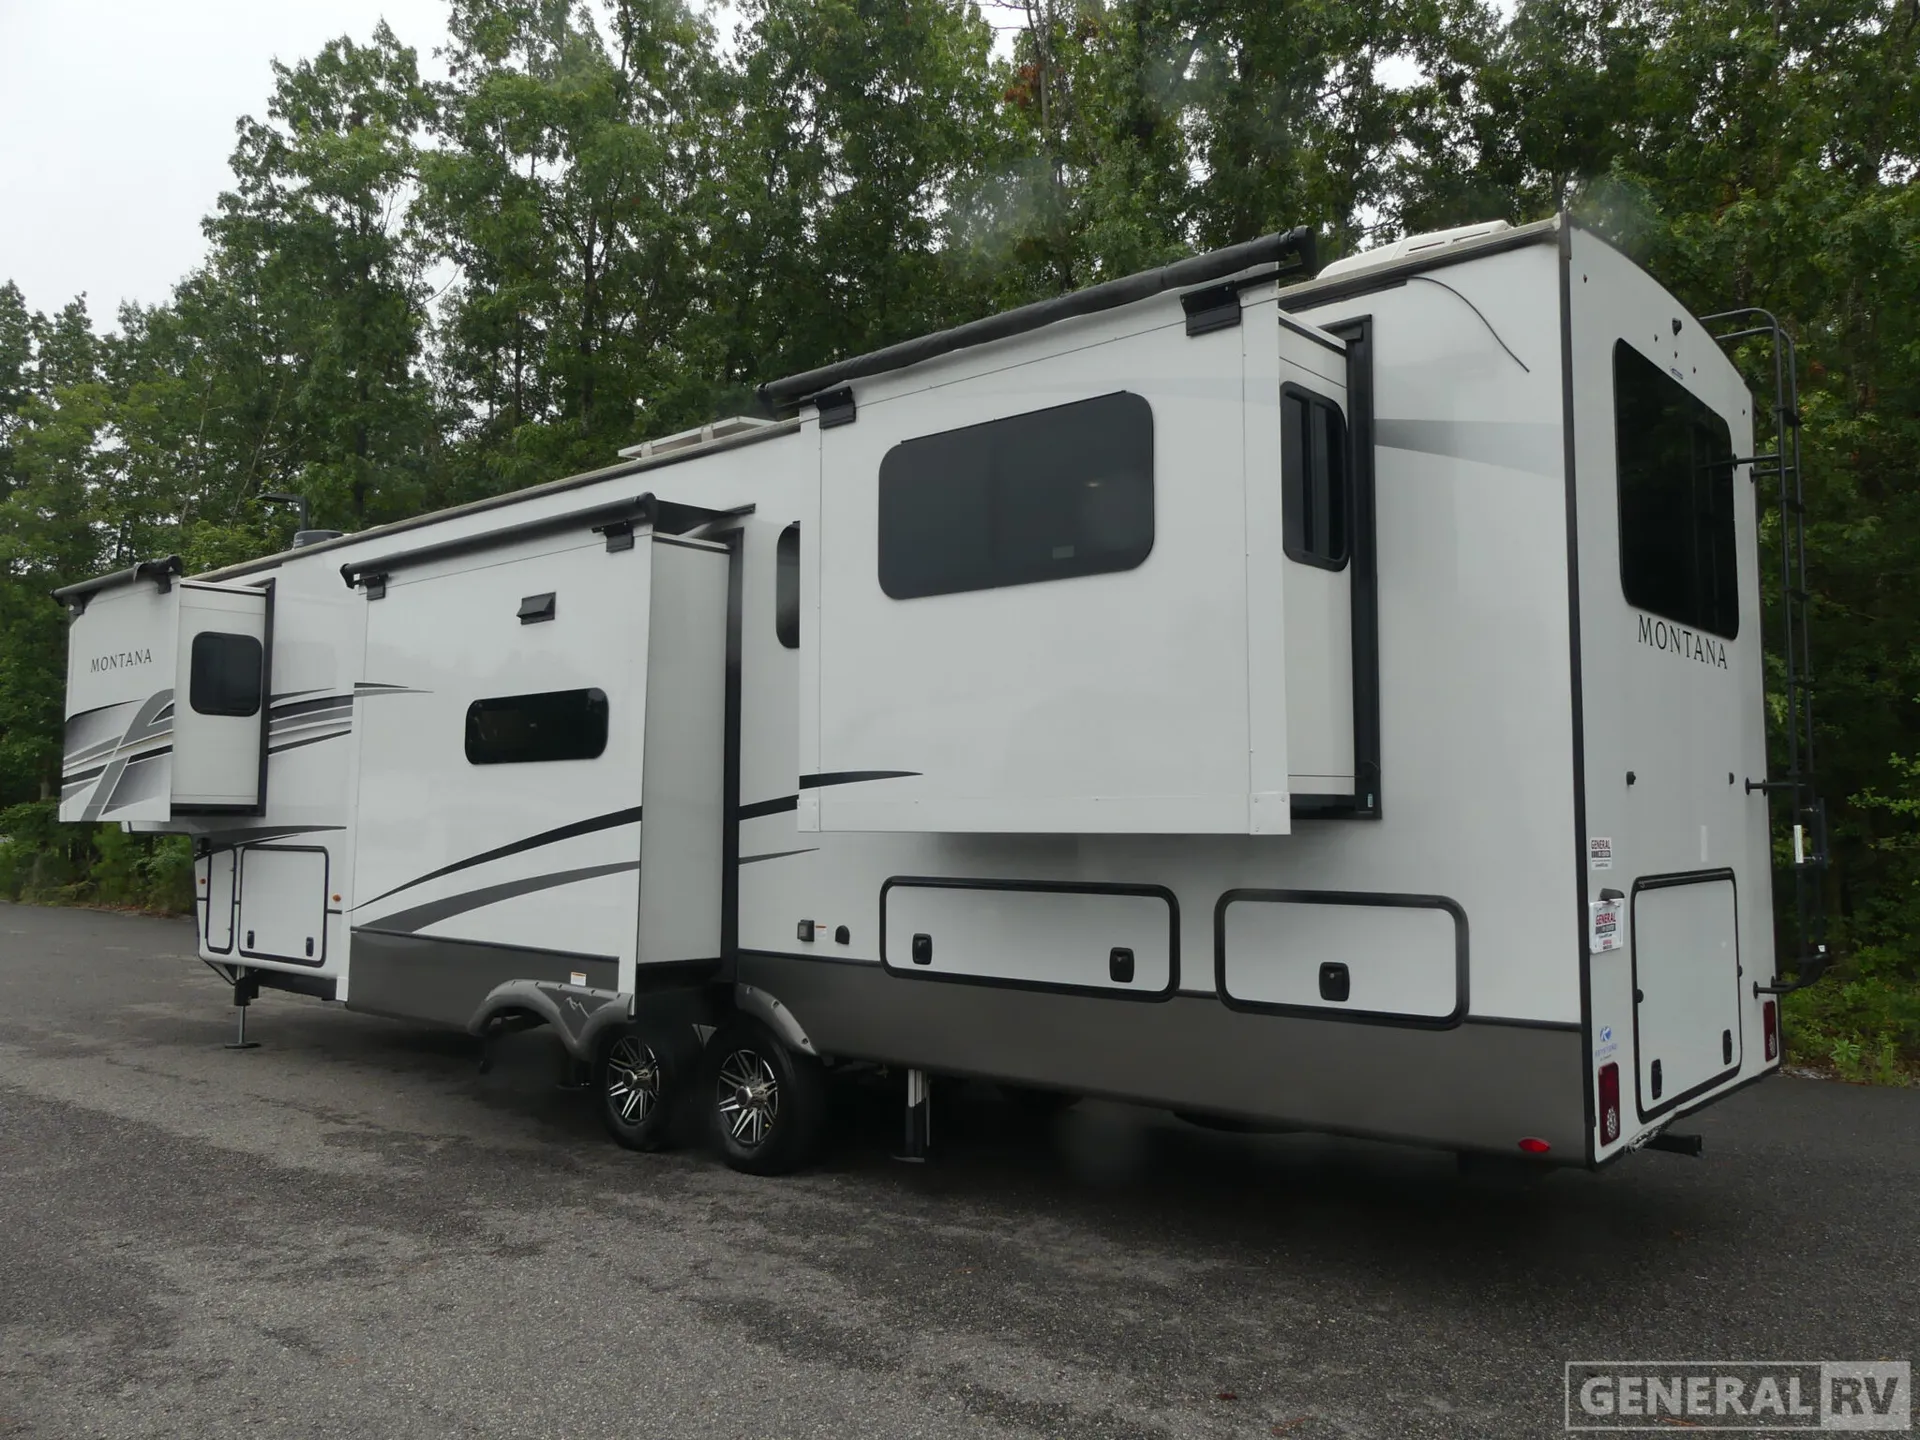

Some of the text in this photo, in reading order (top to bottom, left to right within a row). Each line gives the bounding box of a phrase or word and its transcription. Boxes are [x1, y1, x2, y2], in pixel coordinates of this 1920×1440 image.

[1638, 614, 1728, 670] MONTANA
[90, 648, 152, 673] MONTANA
[1591, 839, 1611, 850] GENERAL
[1595, 912, 1617, 925] GENERAL
